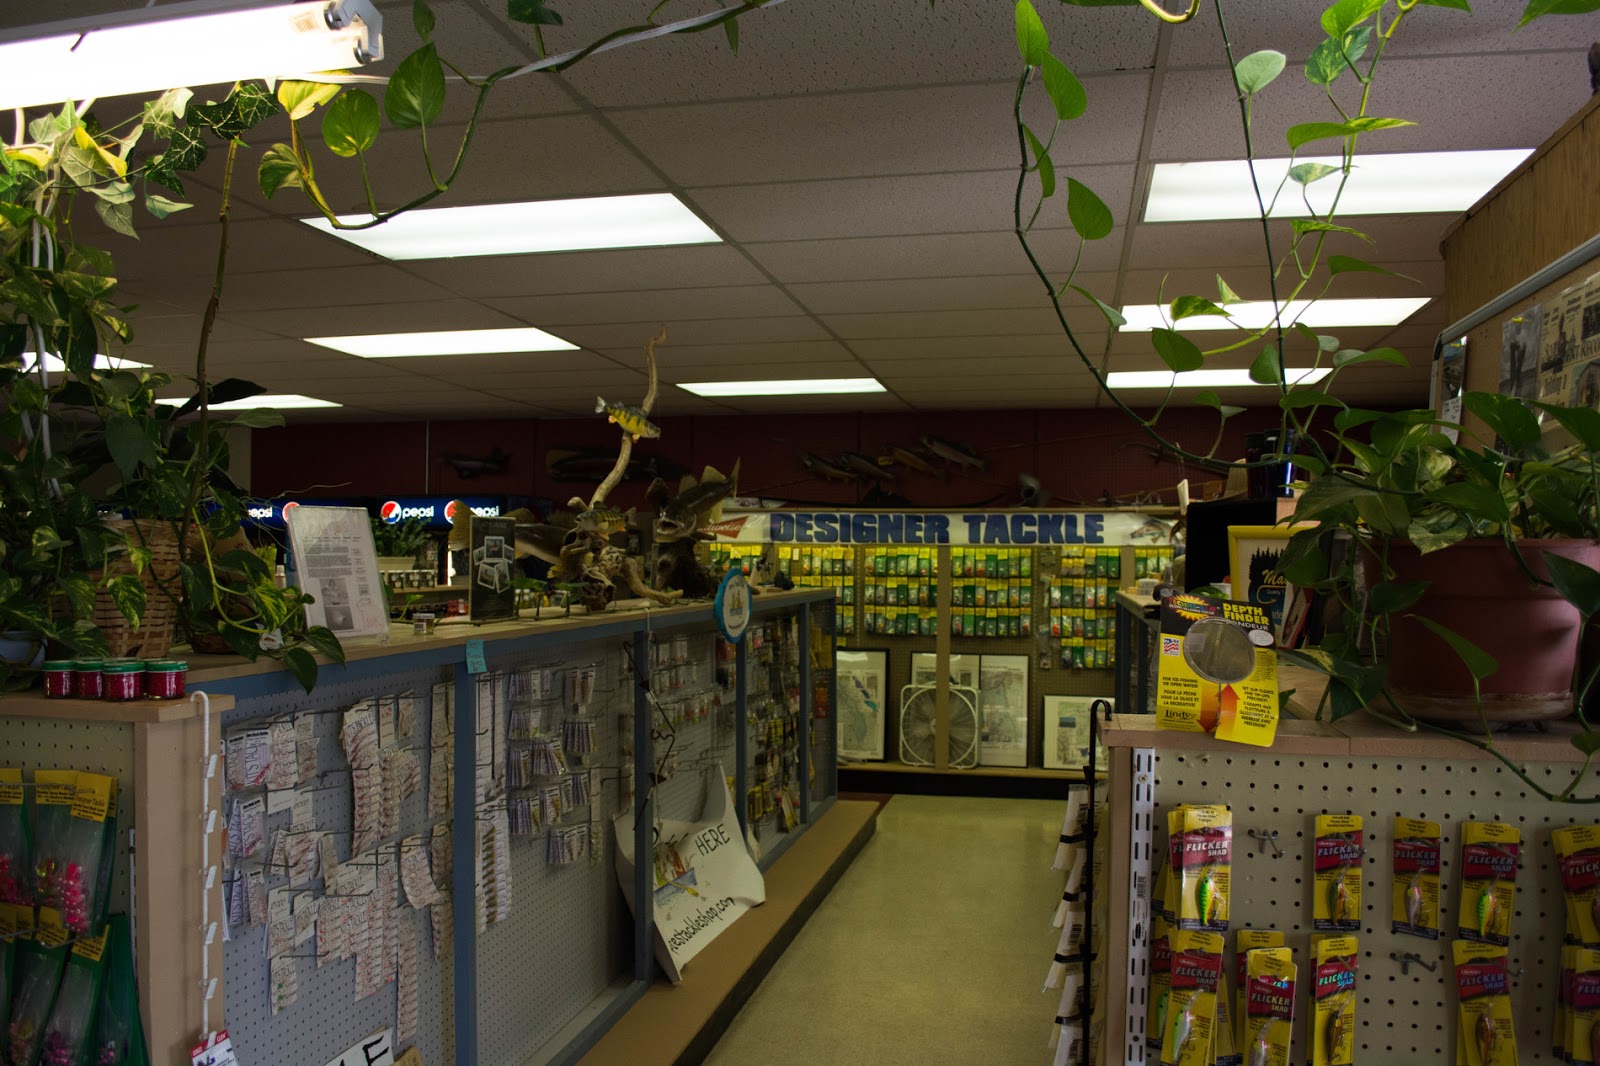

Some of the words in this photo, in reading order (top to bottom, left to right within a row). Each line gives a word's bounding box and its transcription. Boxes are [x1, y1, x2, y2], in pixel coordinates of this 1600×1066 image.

[248, 506, 273, 519] epsi
[402, 505, 434, 519] pepsi
[770, 512, 950, 543] DESIGNER
[963, 514, 1104, 544] TACKLE
[1222, 602, 1263, 616] DEPTH
[1223, 611, 1269, 626] FINDER
[1227, 617, 1269, 630] ONDEUR
[695, 823, 730, 856] HERE
[1186, 840, 1228, 852] FLICKER
[1208, 848, 1228, 857] SHAD
[1339, 852, 1358, 860] SHAD
[1396, 850, 1437, 859] FLICKER
[1468, 855, 1514, 865] FLICKER
[1570, 861, 1600, 876] FLICK
[1175, 966, 1217, 979] FLICKER
[1319, 971, 1355, 986] FLICKER
[1196, 976, 1216, 985] SHAD
[1461, 973, 1504, 986] FLICKER
[1251, 992, 1291, 1006] FLICKER
[1271, 1003, 1289, 1013] SHAD
